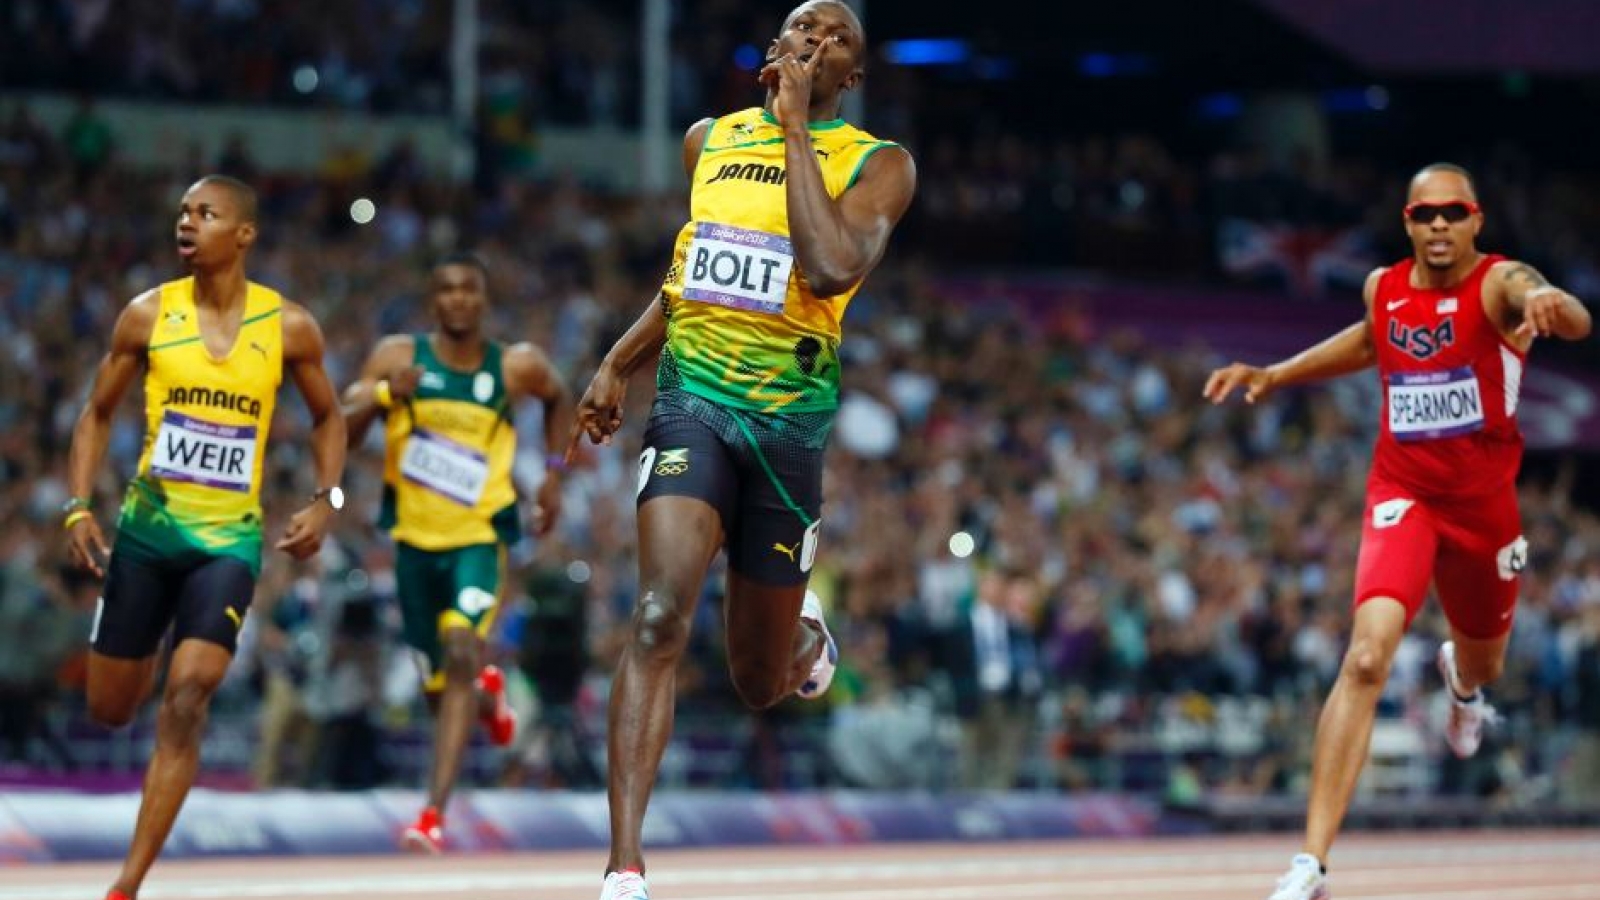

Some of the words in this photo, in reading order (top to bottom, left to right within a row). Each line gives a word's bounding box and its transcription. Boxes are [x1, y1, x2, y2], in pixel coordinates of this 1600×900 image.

[693, 247, 780, 293] BOLT
[1388, 317, 1455, 360] USA
[162, 387, 261, 419] JAMAICA
[1393, 387, 1477, 423] SPEARMON
[168, 433, 246, 475] WEIR
